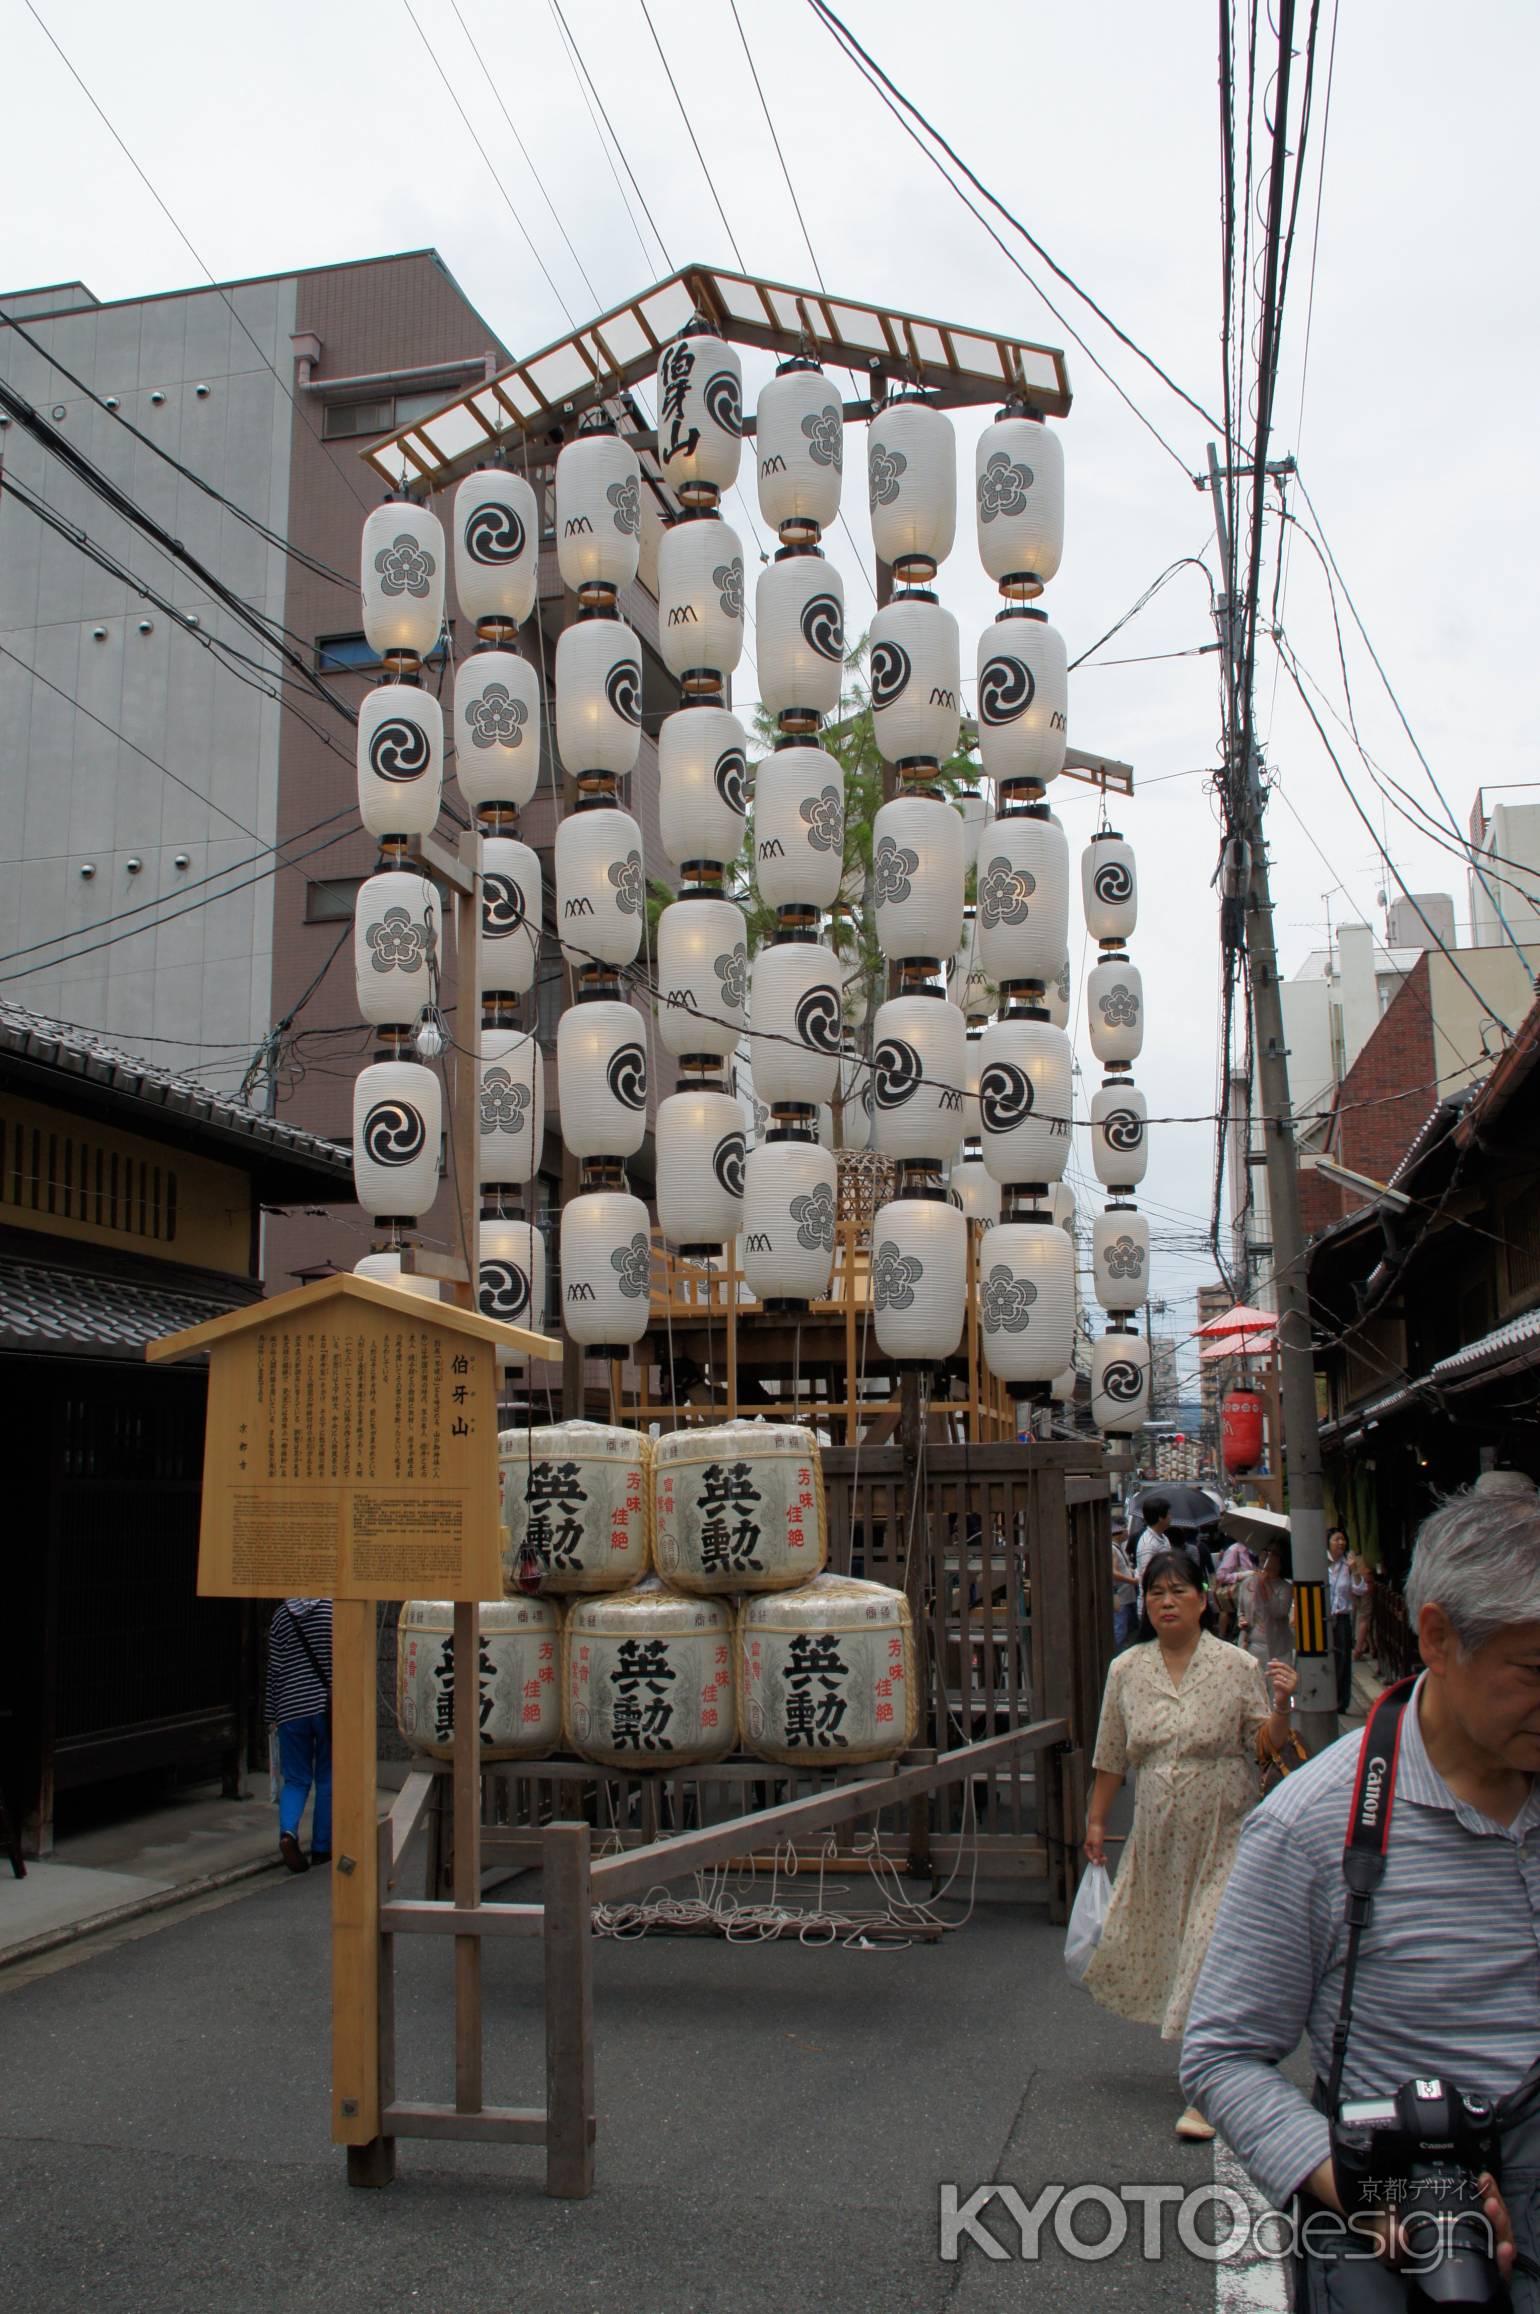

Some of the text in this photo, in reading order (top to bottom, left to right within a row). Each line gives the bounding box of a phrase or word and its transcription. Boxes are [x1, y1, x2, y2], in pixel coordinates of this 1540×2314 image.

[661, 341, 701, 464] 伯牙山
[451, 1353, 469, 1437] 伯牙山
[626, 1471, 641, 1514] 芳味
[798, 1467, 814, 1509] 芳味
[697, 1463, 764, 1573] 英勲
[786, 1504, 804, 1548] 佳絶
[539, 1641, 555, 1683] 芳味
[714, 1645, 730, 1688] 芳味
[888, 1637, 904, 1681] 芳味
[610, 1640, 676, 1751] 英勲
[782, 1633, 849, 1748] 英勲
[1361, 1756, 1387, 1826] Canon
[1419, 2141, 1455, 2150] Canon
